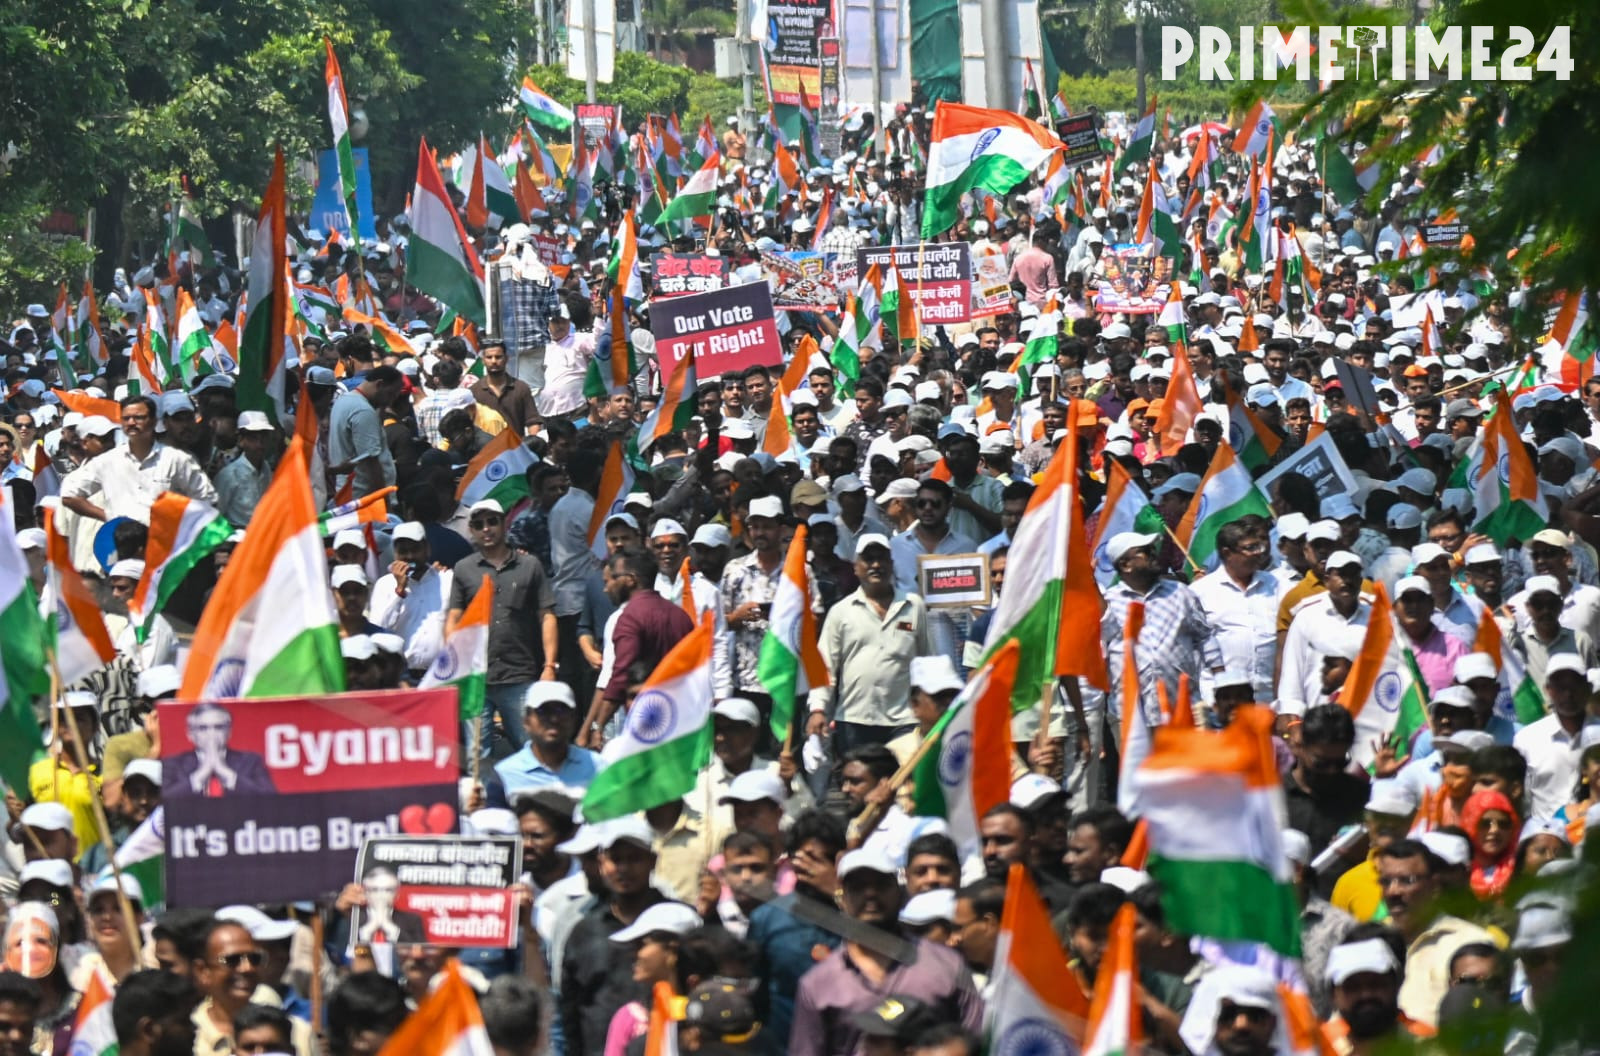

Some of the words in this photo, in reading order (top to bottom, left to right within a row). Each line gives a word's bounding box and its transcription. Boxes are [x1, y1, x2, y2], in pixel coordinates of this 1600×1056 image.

[934, 262, 961, 280] दोरी,
[660, 275, 686, 292] चले
[937, 285, 961, 299] केली
[674, 315, 705, 334] Our
[708, 306, 753, 327] Vote
[920, 303, 963, 319] ोटचोरी!
[709, 326, 765, 354] Right!
[932, 575, 976, 589] HACKED
[265, 724, 450, 776] Gyanu,
[171, 823, 227, 858] It's
[234, 820, 321, 855] done
